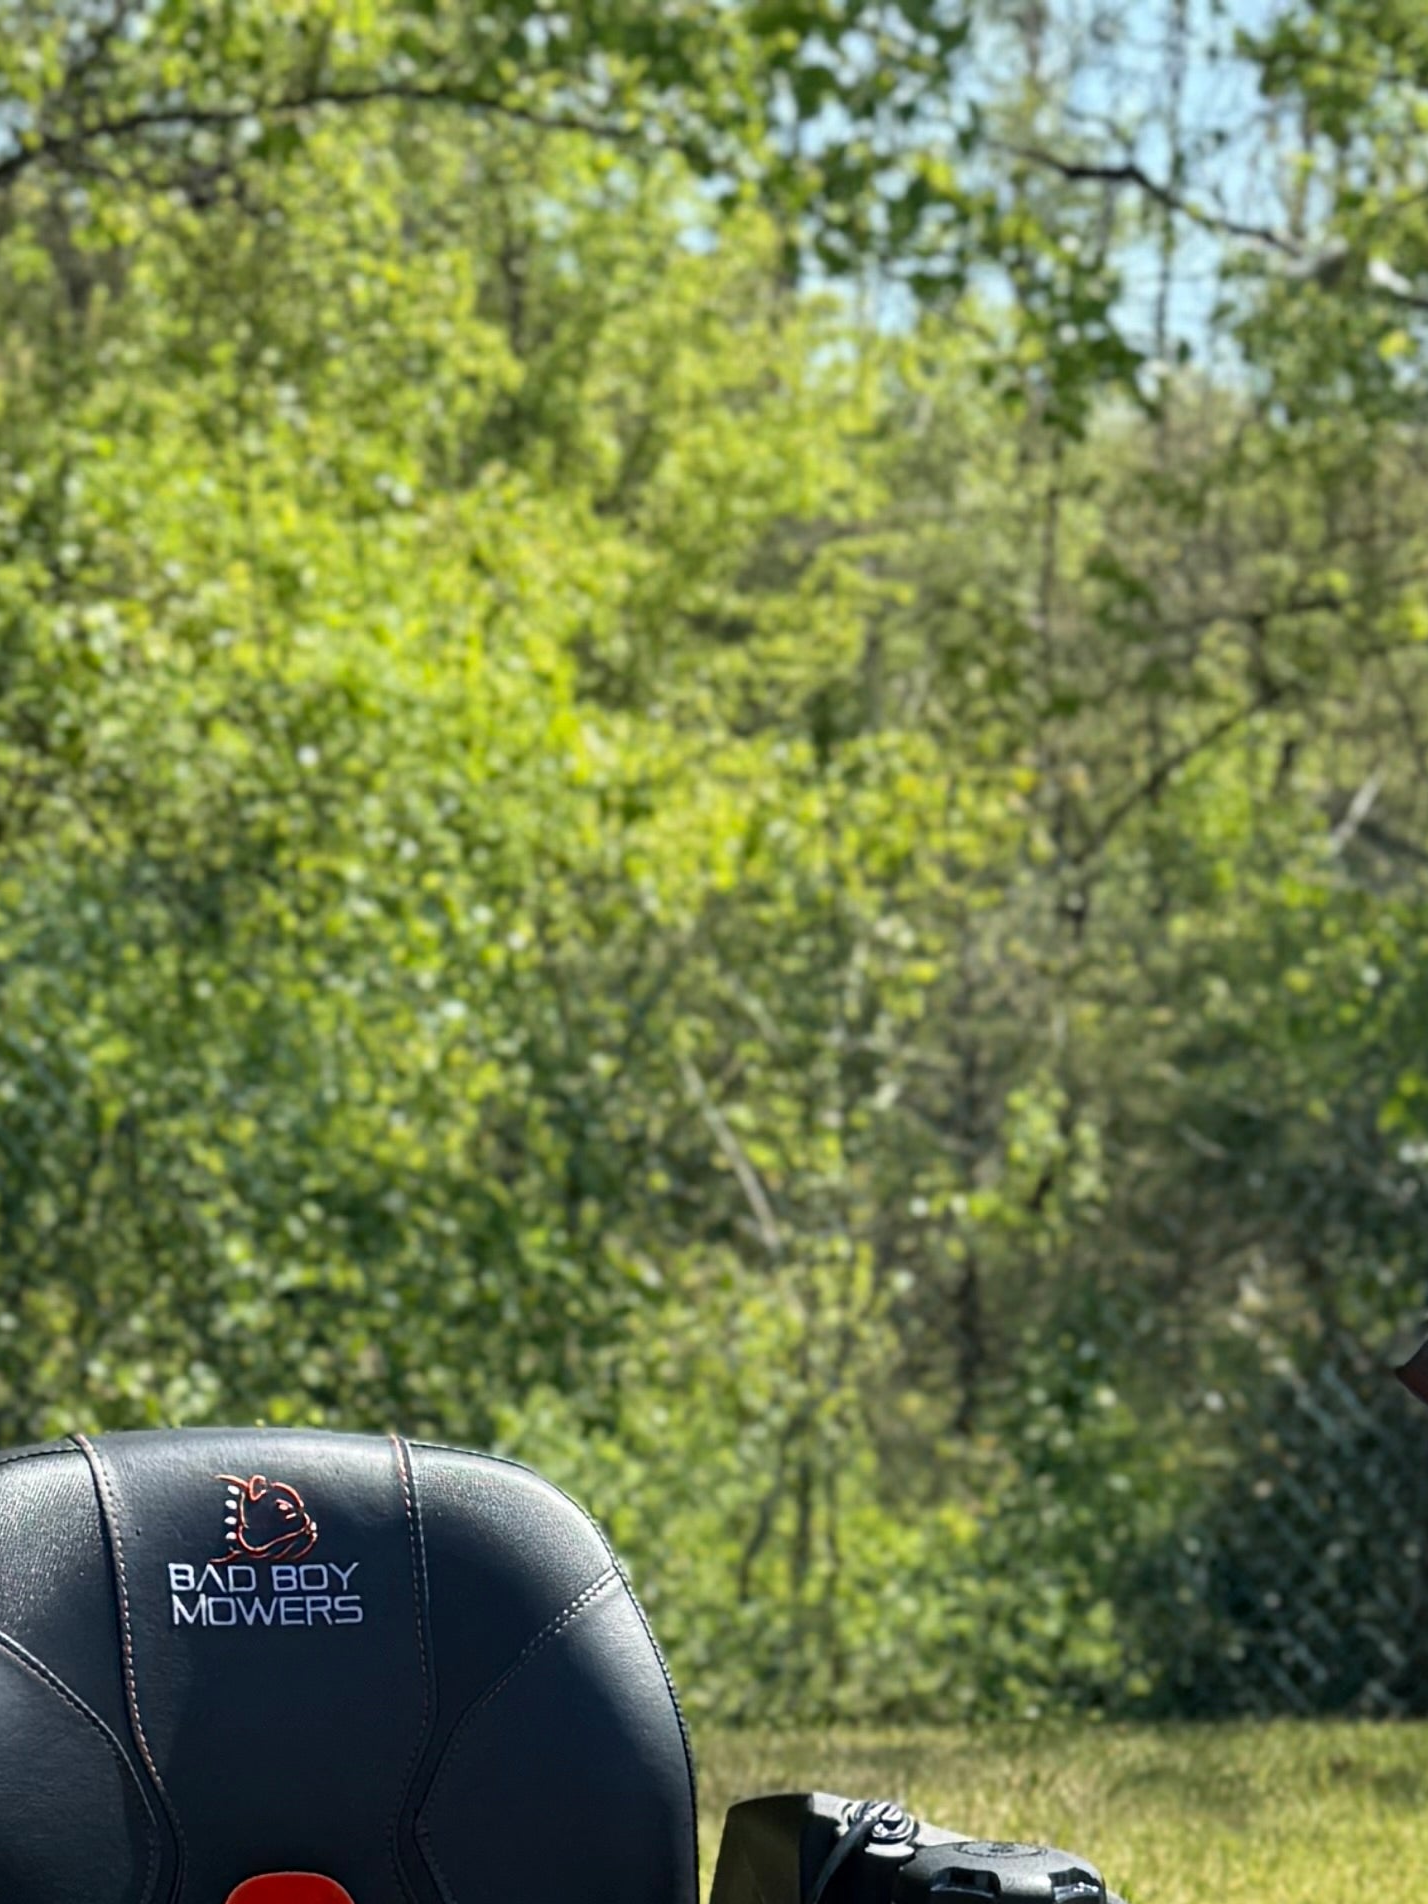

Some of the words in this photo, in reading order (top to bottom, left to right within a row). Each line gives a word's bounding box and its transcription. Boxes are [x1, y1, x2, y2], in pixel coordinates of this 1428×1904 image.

[168, 1562, 257, 1593] BAD
[271, 1562, 360, 1592] BOY
[172, 1593, 364, 1627] MOWERS
